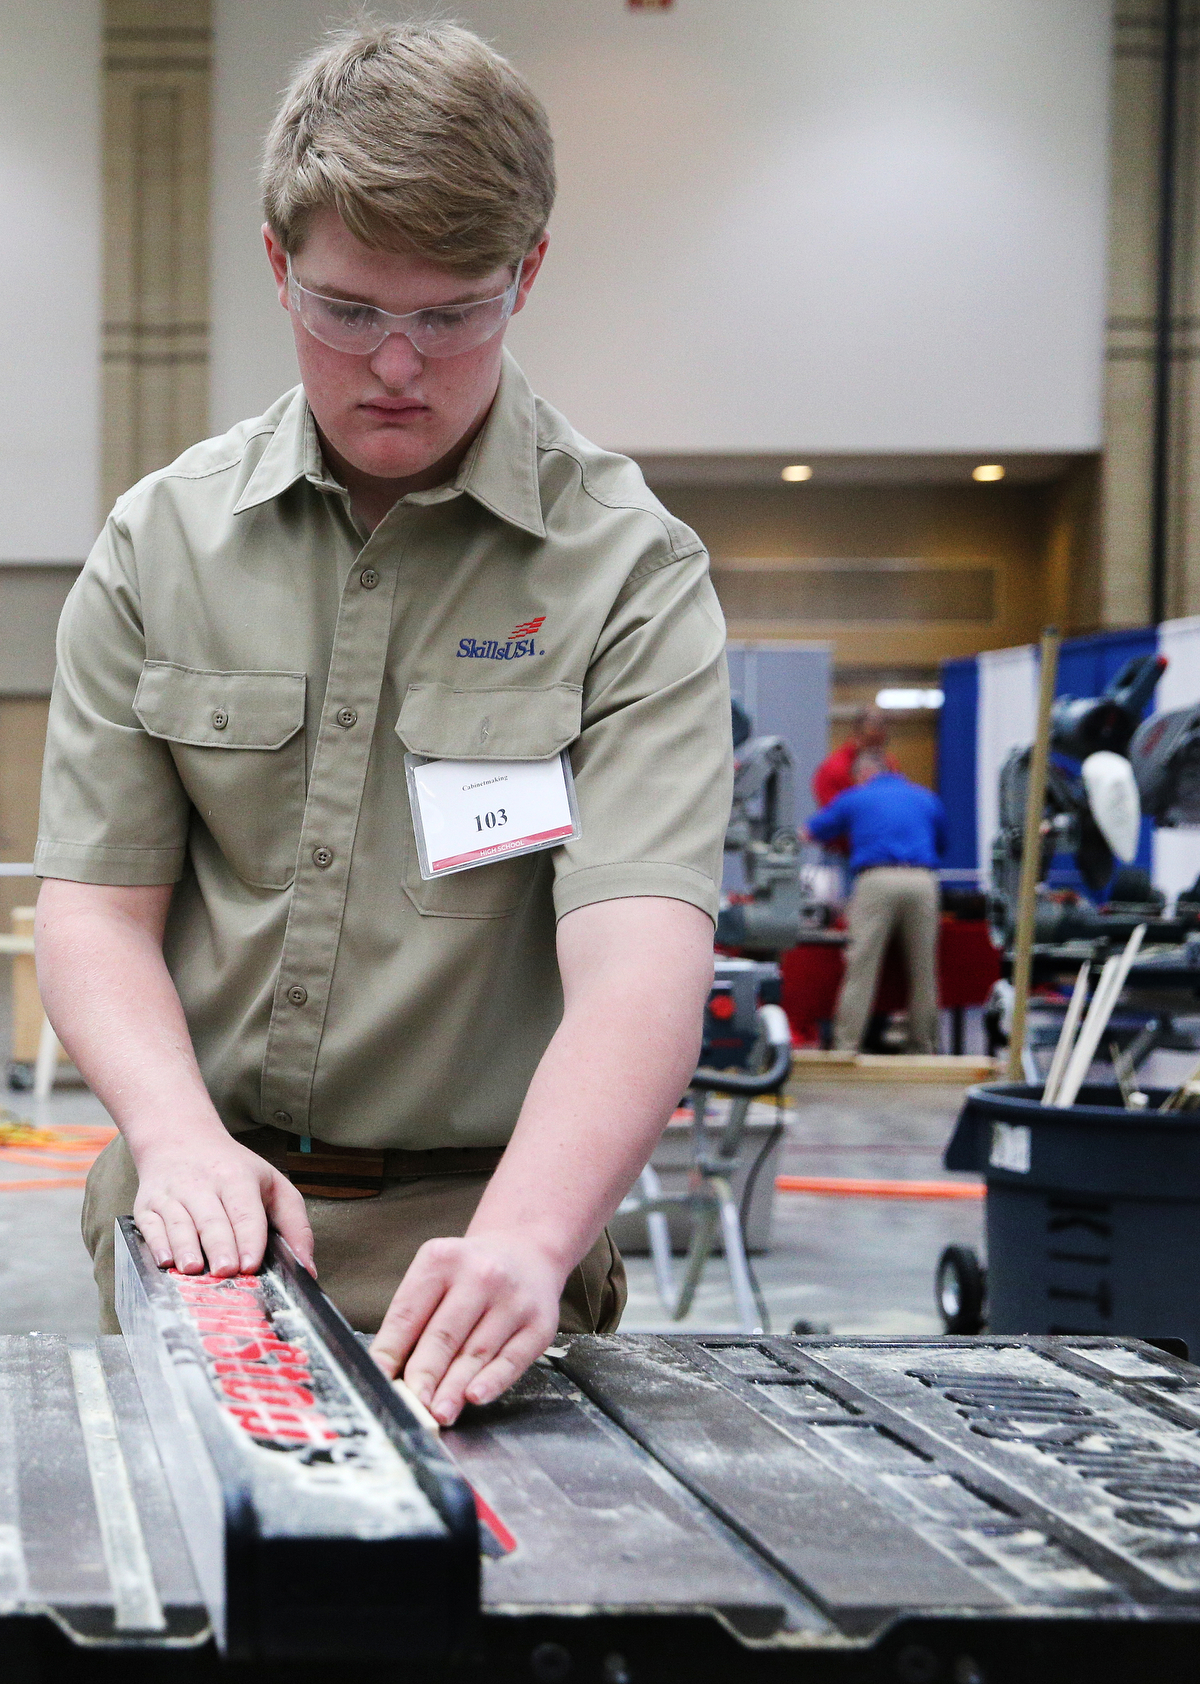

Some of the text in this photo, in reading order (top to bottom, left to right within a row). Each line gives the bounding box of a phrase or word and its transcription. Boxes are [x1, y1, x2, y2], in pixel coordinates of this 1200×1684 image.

[461, 775, 509, 791] Cabinetmaking
[474, 808, 509, 832] 103
[479, 840, 525, 857] HIGH SCHOOL
[1048, 1201, 1112, 1336] KIT
